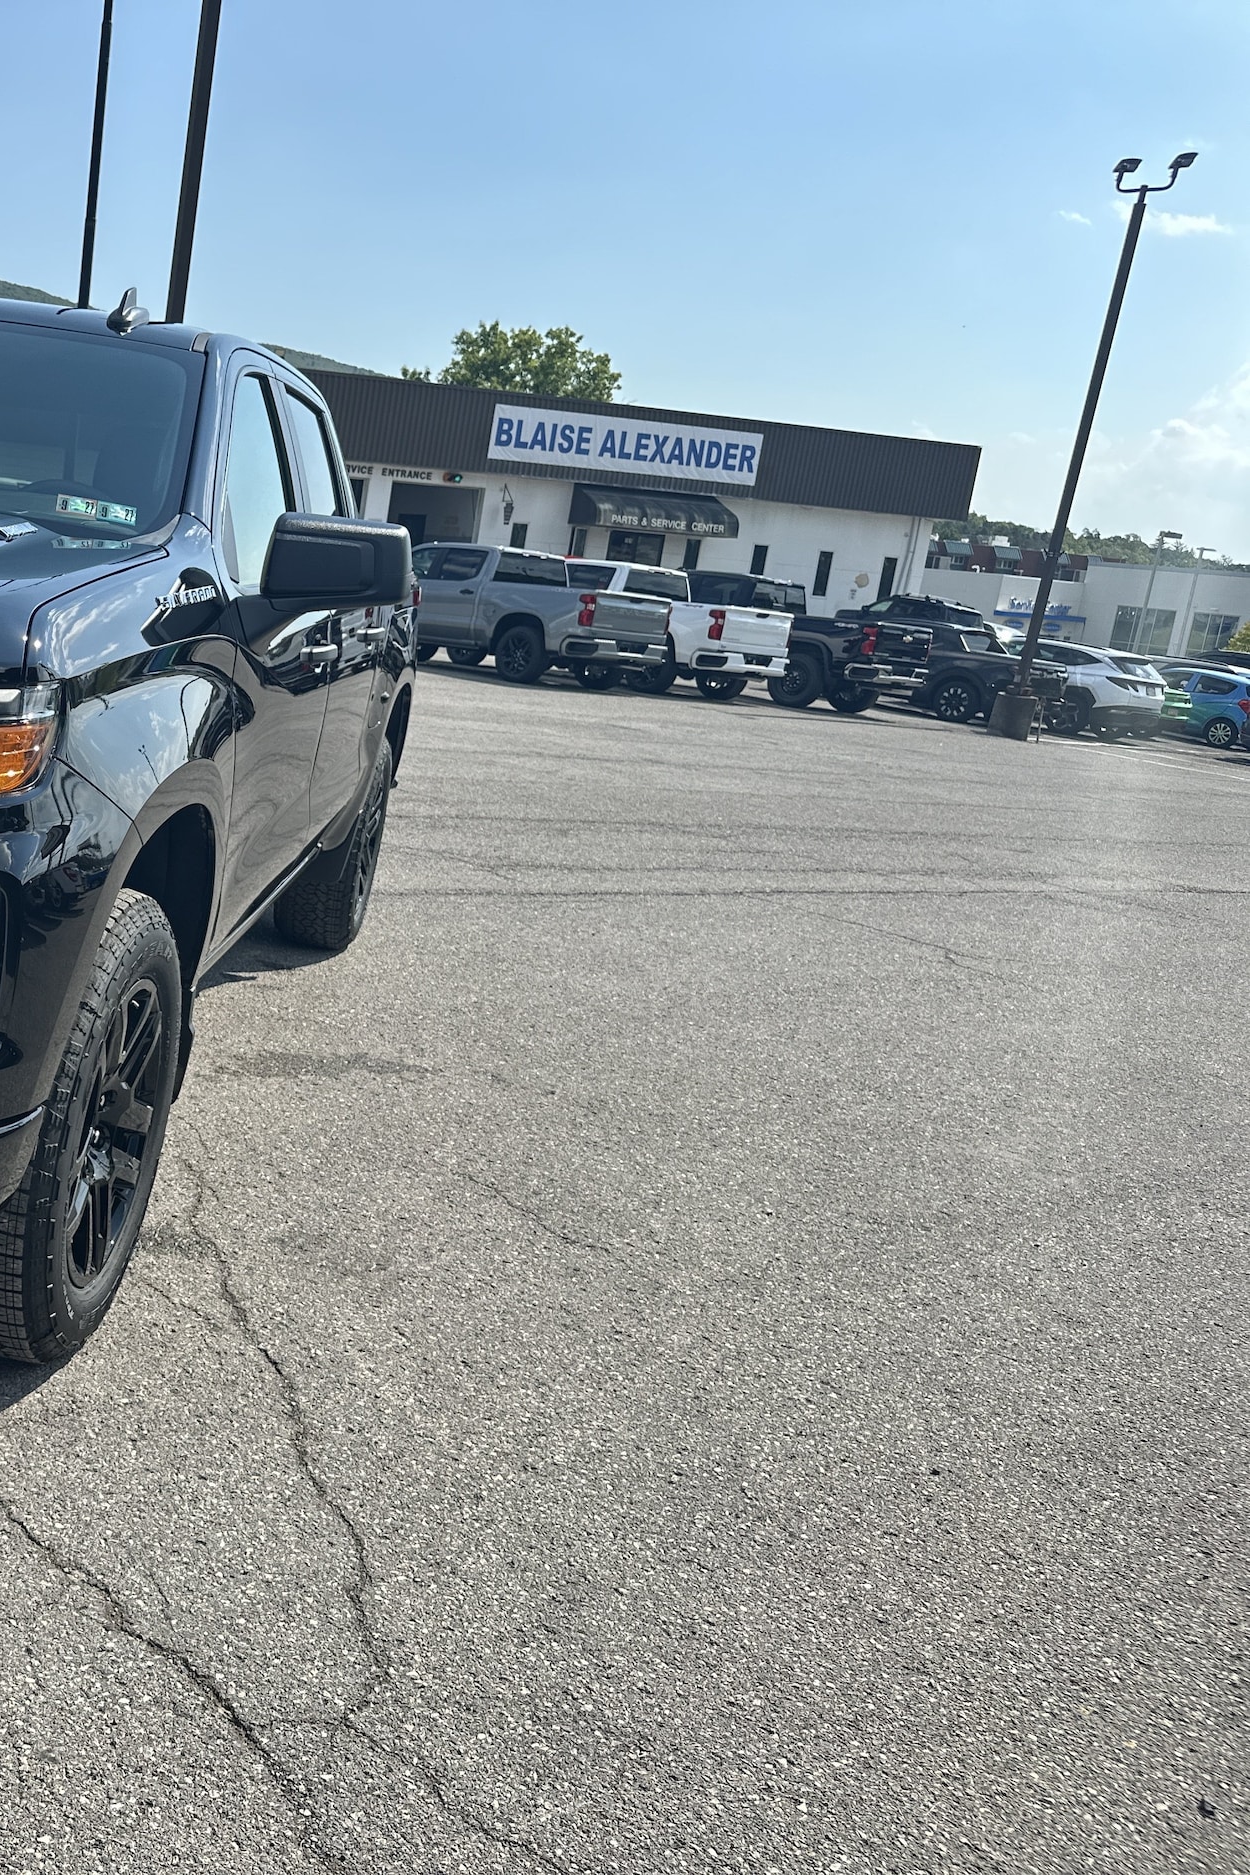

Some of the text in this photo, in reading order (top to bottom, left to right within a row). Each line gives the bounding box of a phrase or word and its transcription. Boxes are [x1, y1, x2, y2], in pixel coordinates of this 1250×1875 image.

[494, 417, 757, 473] BLAISE ALEXANDER
[346, 464, 433, 480] RVICE ENTRANCE
[61, 499, 94, 515] 9 27
[101, 506, 134, 522] 9 27
[611, 514, 725, 534] PARTS & SERVICE CENTER
[1009, 596, 1071, 616] Servi enter
